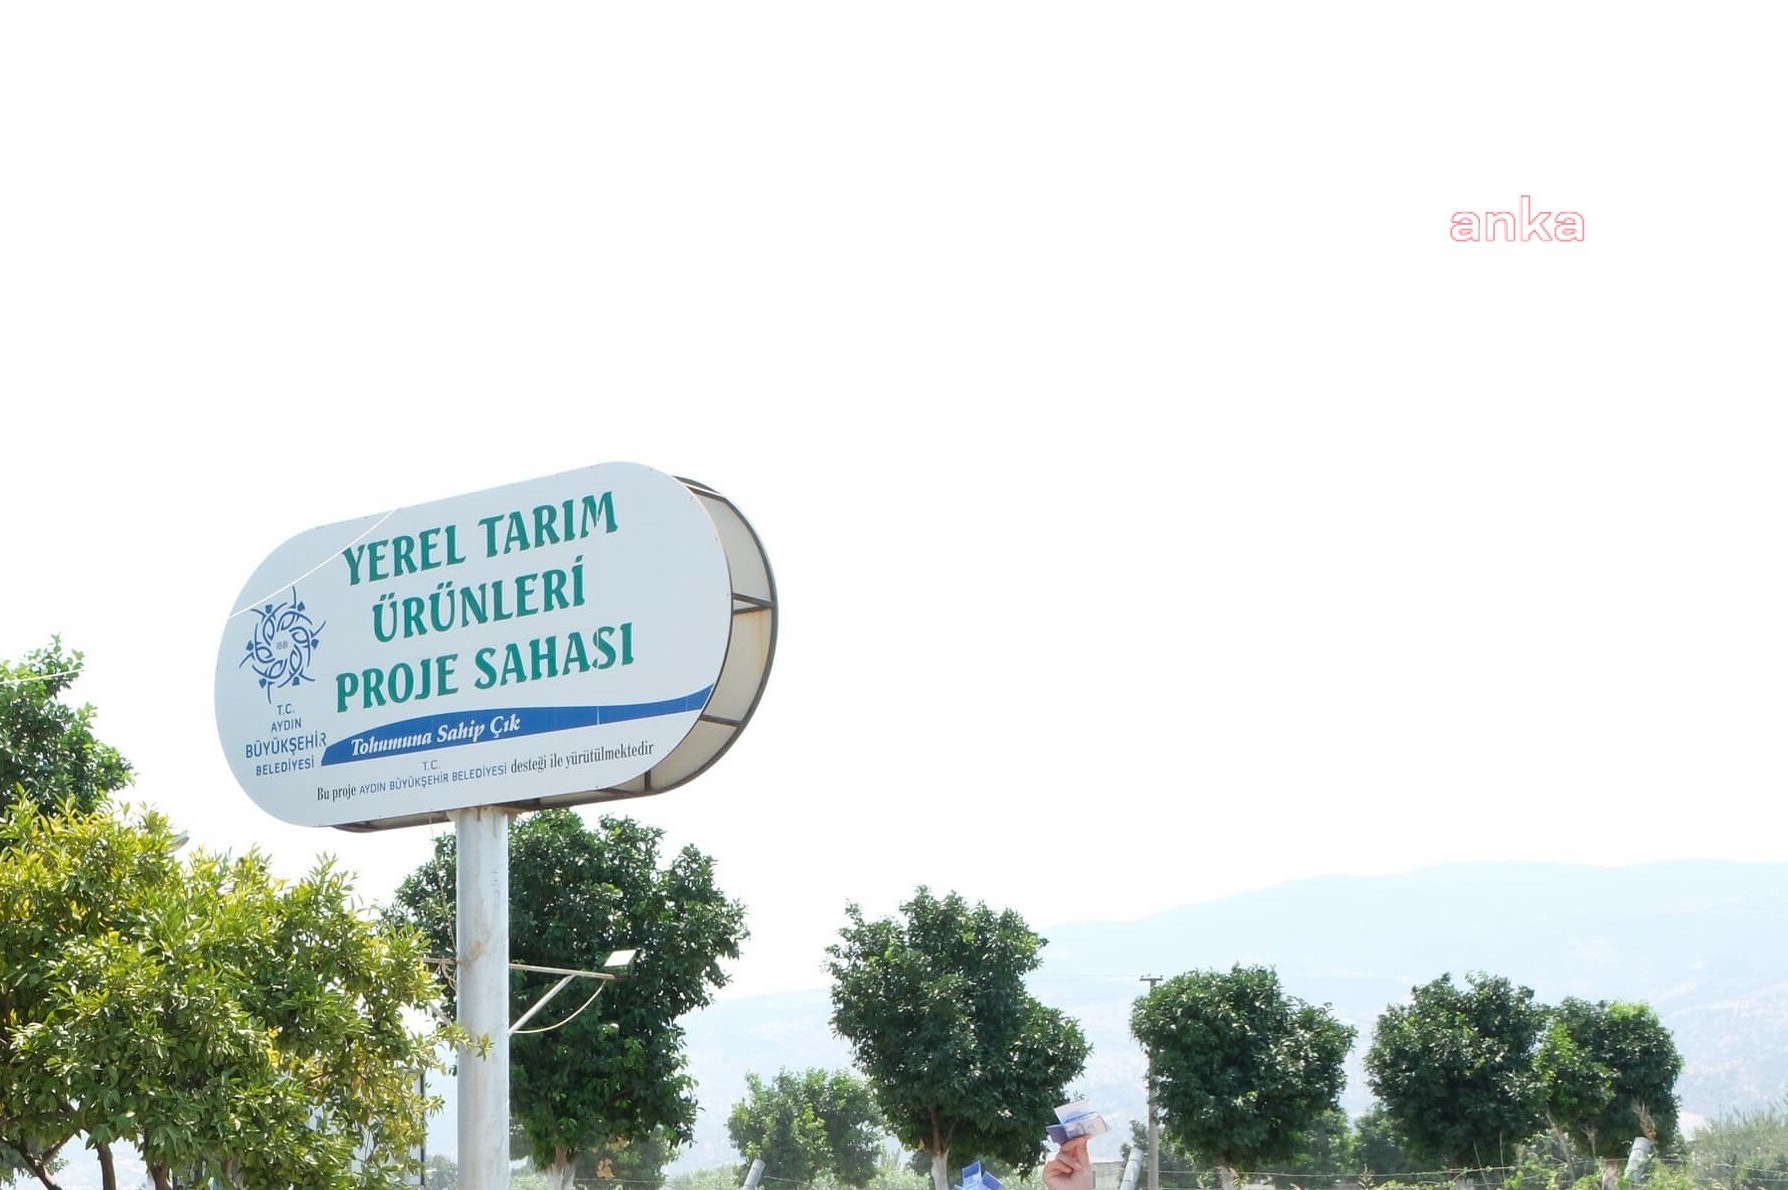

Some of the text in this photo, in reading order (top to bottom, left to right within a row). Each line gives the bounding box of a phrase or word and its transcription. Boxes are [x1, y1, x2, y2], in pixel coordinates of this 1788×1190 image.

[342, 491, 618, 586] YEREL TARIM
[372, 555, 585, 642] ÜRÜNLERİ
[336, 622, 634, 713] PROJE SAHASI
[271, 717, 302, 732] AYDIN
[277, 703, 295, 716] T.C.
[245, 730, 327, 759] BÜYÜKŞEHİR
[351, 713, 521, 756] Tohumuna Sahip Çık
[256, 755, 314, 776] BELEDİYESİ
[317, 740, 654, 802] Bu proje AYDIN BÜYÜKŞEHİR BELEDİYESİ desteği ile yürütülmektedir
[422, 760, 441, 771] T.C.
